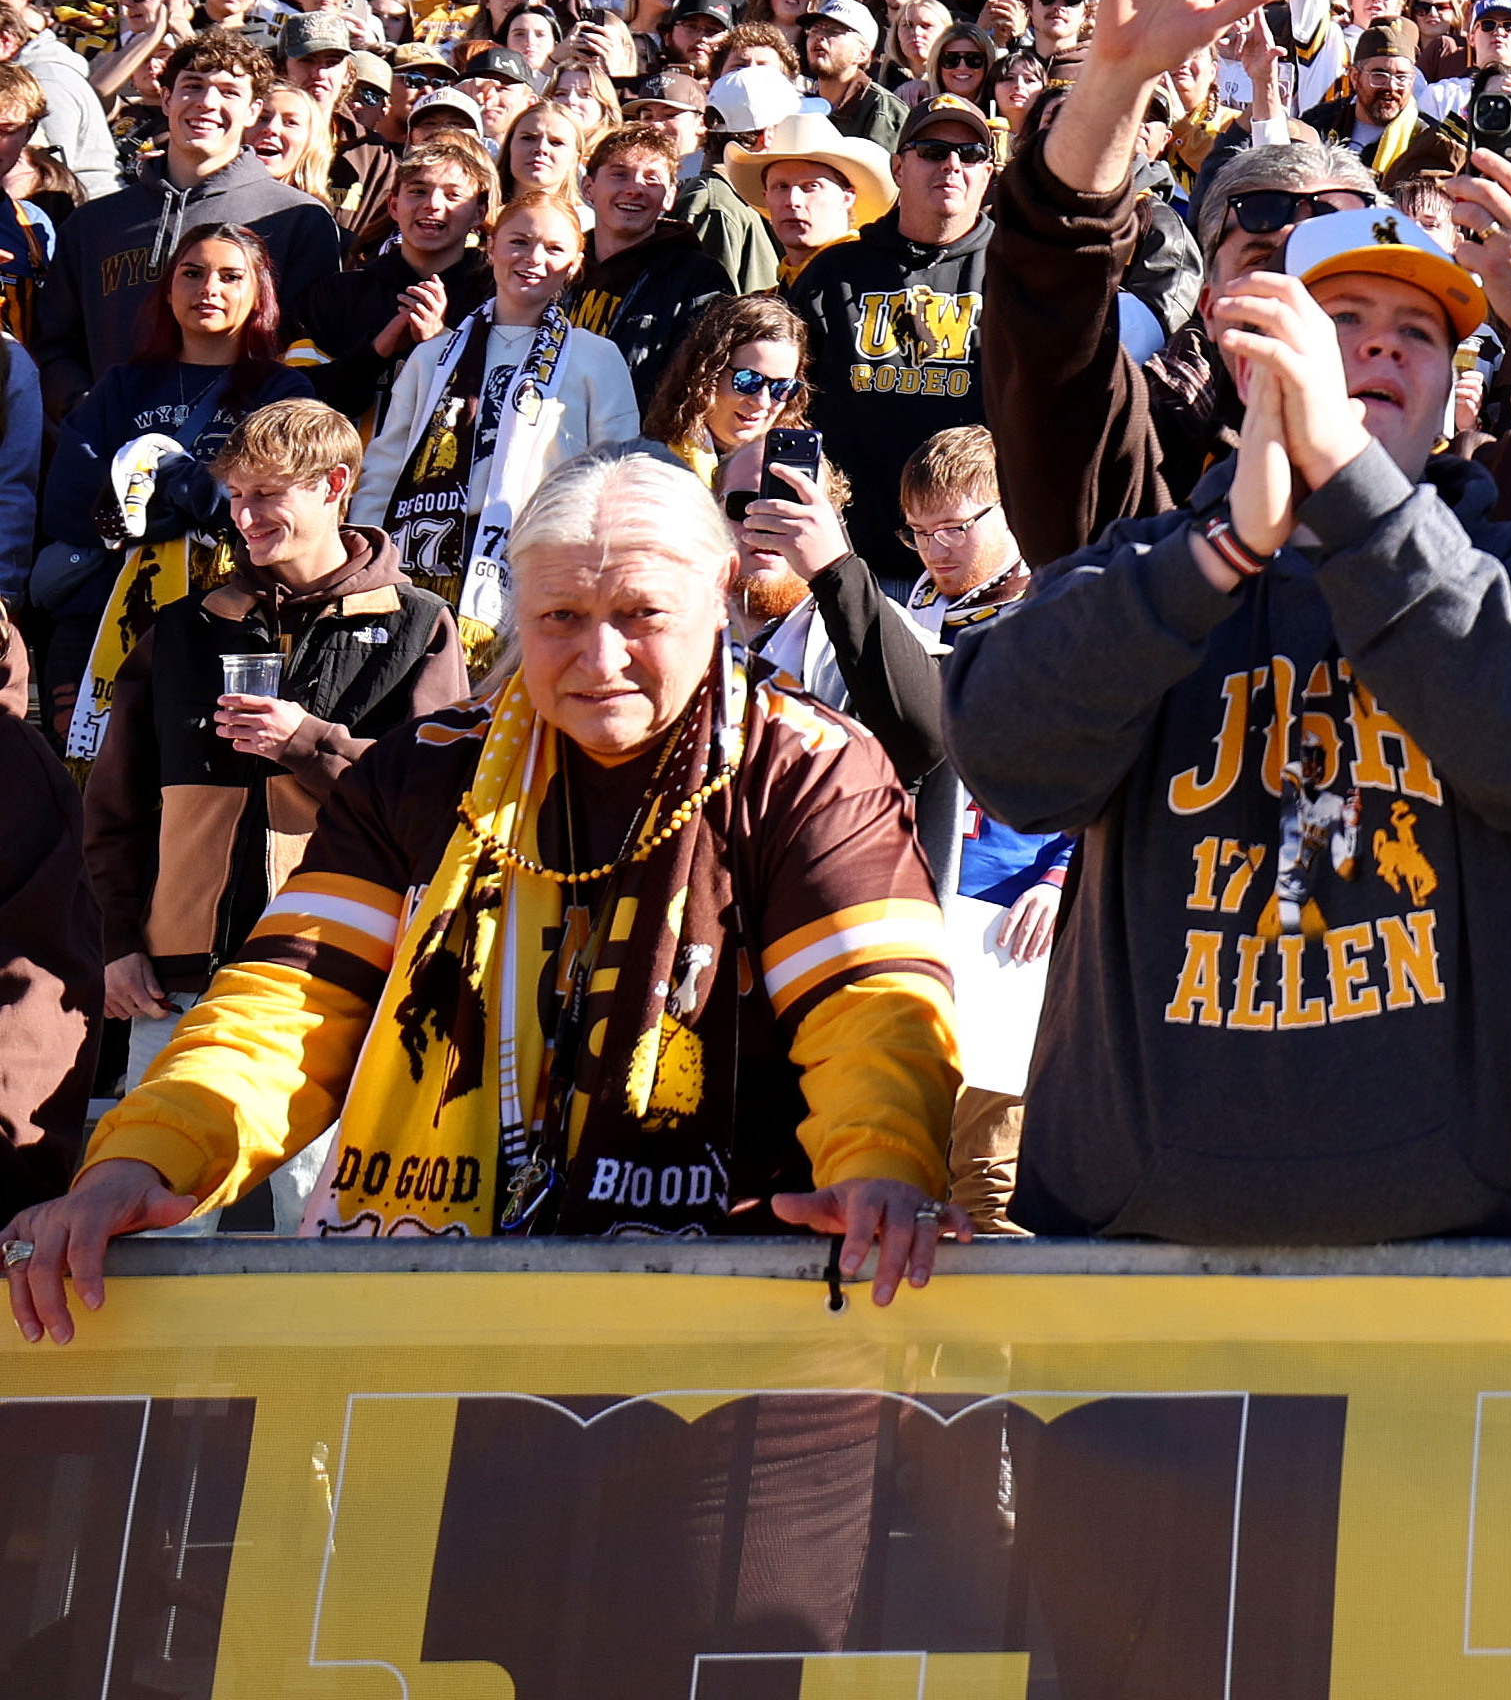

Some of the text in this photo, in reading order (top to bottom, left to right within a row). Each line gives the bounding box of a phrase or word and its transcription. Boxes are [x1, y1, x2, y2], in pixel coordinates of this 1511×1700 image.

[854, 290, 984, 365] UW
[849, 363, 971, 398] RODEO
[414, 490, 461, 514] GOOD
[390, 517, 456, 576] 17
[1185, 834, 1267, 914] 17
[1164, 908, 1446, 1032] ALLEN
[330, 1145, 483, 1204] DO GOOD
